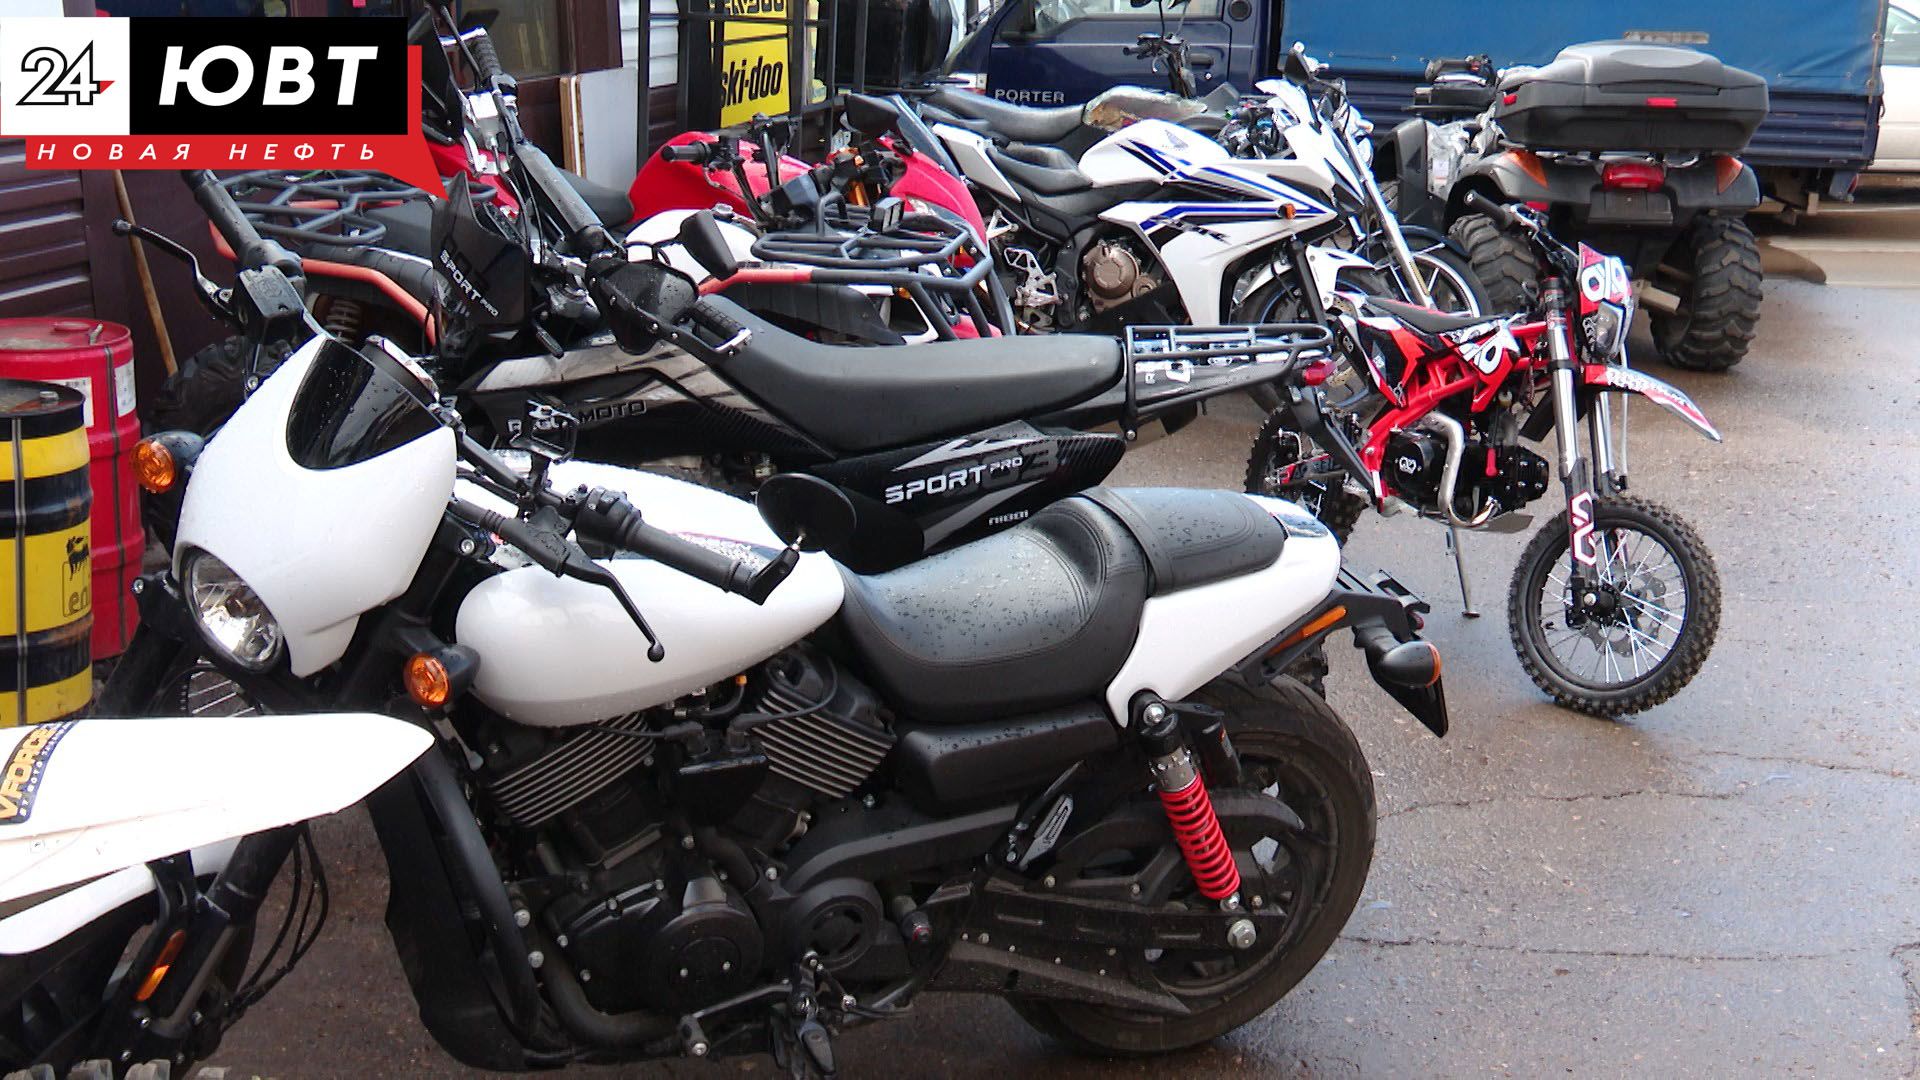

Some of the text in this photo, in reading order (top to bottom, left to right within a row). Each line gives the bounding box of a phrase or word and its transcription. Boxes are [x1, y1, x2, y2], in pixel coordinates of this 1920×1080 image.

[720, 55, 784, 107] ski-doo
[994, 89, 1065, 104] PORTER
[440, 249, 482, 300] SPORT
[480, 298, 499, 316] PRO
[884, 456, 1023, 505] SPORT PRO
